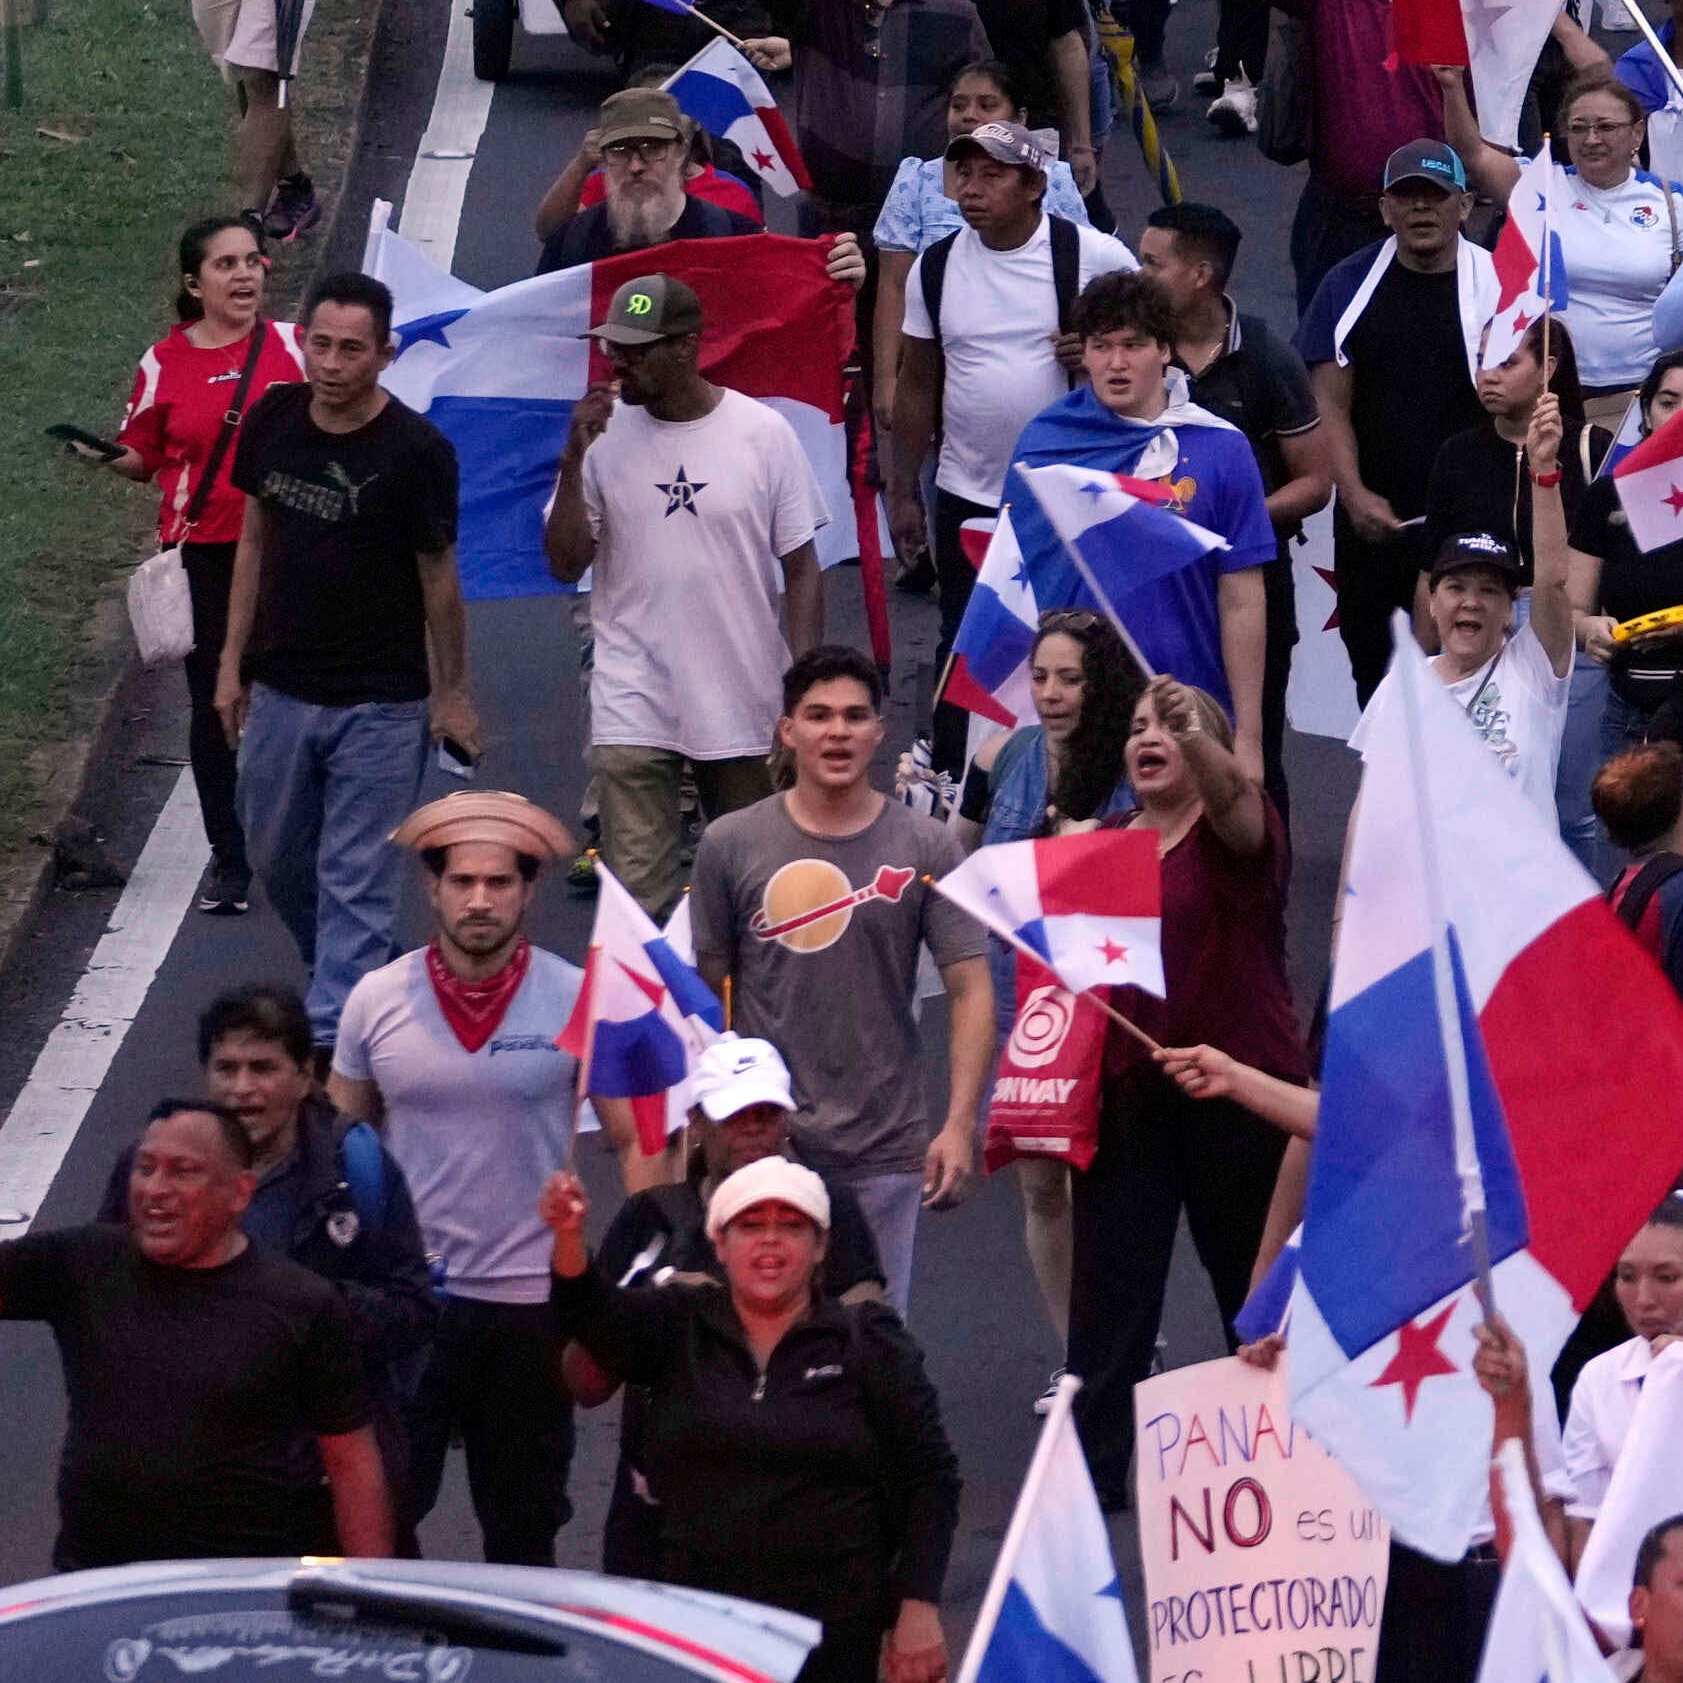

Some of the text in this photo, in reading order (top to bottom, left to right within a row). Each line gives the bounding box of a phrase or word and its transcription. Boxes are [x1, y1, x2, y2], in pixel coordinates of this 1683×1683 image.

[1169, 1475, 1383, 1562] NO es un
[1151, 1574, 1379, 1651] PROTECTORADO
